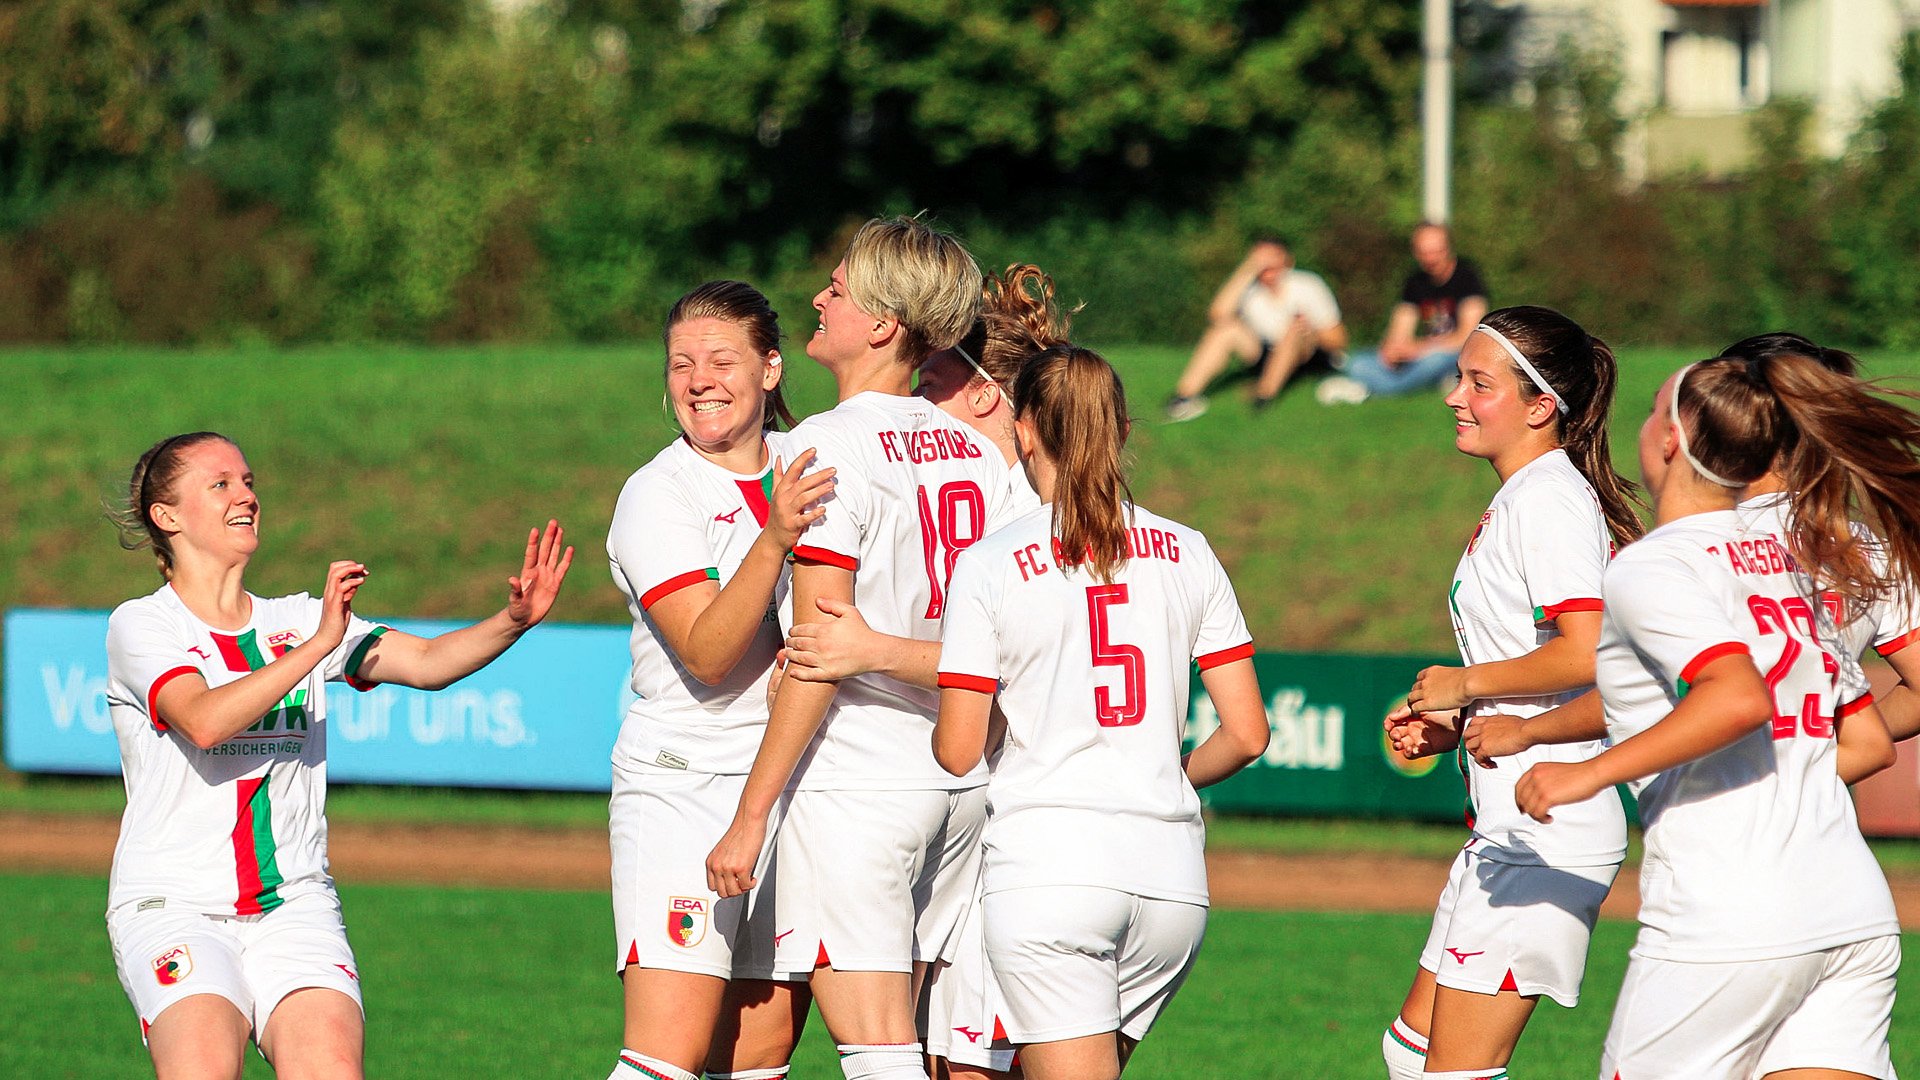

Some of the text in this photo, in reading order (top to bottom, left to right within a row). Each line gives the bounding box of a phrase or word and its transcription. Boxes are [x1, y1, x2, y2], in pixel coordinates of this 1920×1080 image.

[878, 428, 982, 464] FC GSBURG
[917, 480, 985, 619] 18
[1013, 543, 1048, 582] FC
[1086, 583, 1147, 728] 5
[1748, 595, 1839, 740] 23
